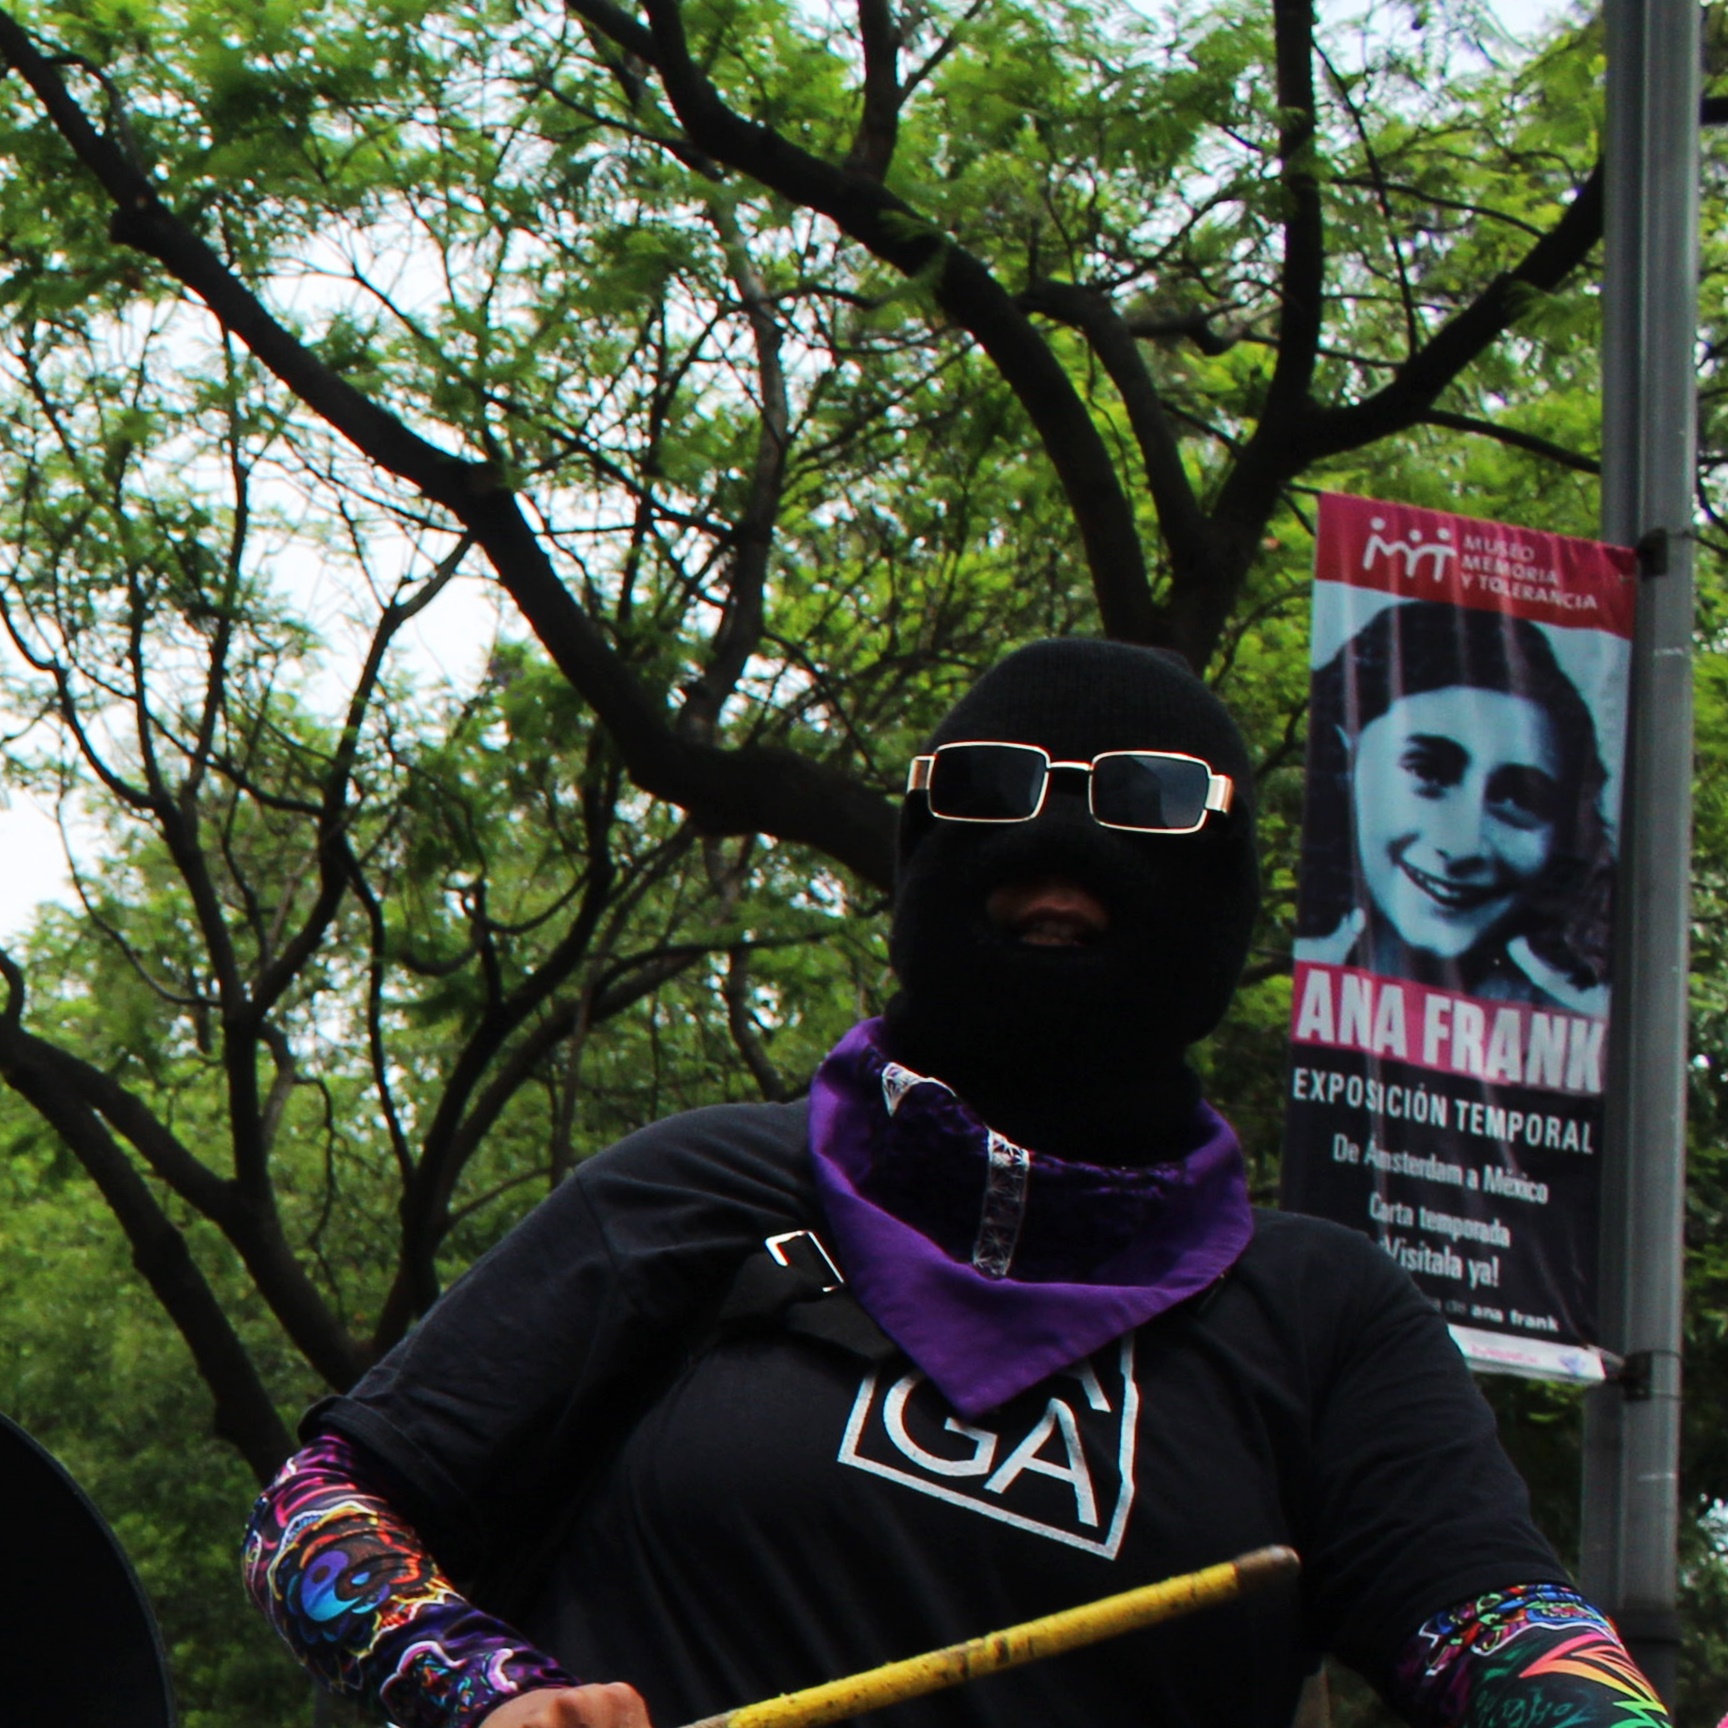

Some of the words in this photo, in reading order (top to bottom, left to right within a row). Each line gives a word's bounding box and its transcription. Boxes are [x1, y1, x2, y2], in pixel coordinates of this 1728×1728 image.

[1463, 534, 1535, 560] MUSEO
[1460, 554, 1559, 585] MEMORIA
[1460, 573, 1473, 588] Y
[1479, 574, 1598, 610] TOLERANCIA
[1297, 967, 1407, 1059] ANA
[1423, 993, 1604, 1094] FRANK
[1294, 1067, 1448, 1128] EXPOSICIÓN
[1455, 1099, 1594, 1155] TEMPORAL
[1333, 1133, 1360, 1164] De
[1468, 1168, 1479, 1191] a
[1483, 1164, 1549, 1205] México
[1419, 1206, 1510, 1248] temporada
[1468, 1256, 1499, 1290] ya!
[1471, 1304, 1504, 1323] ana
[1510, 1310, 1559, 1332] frank
